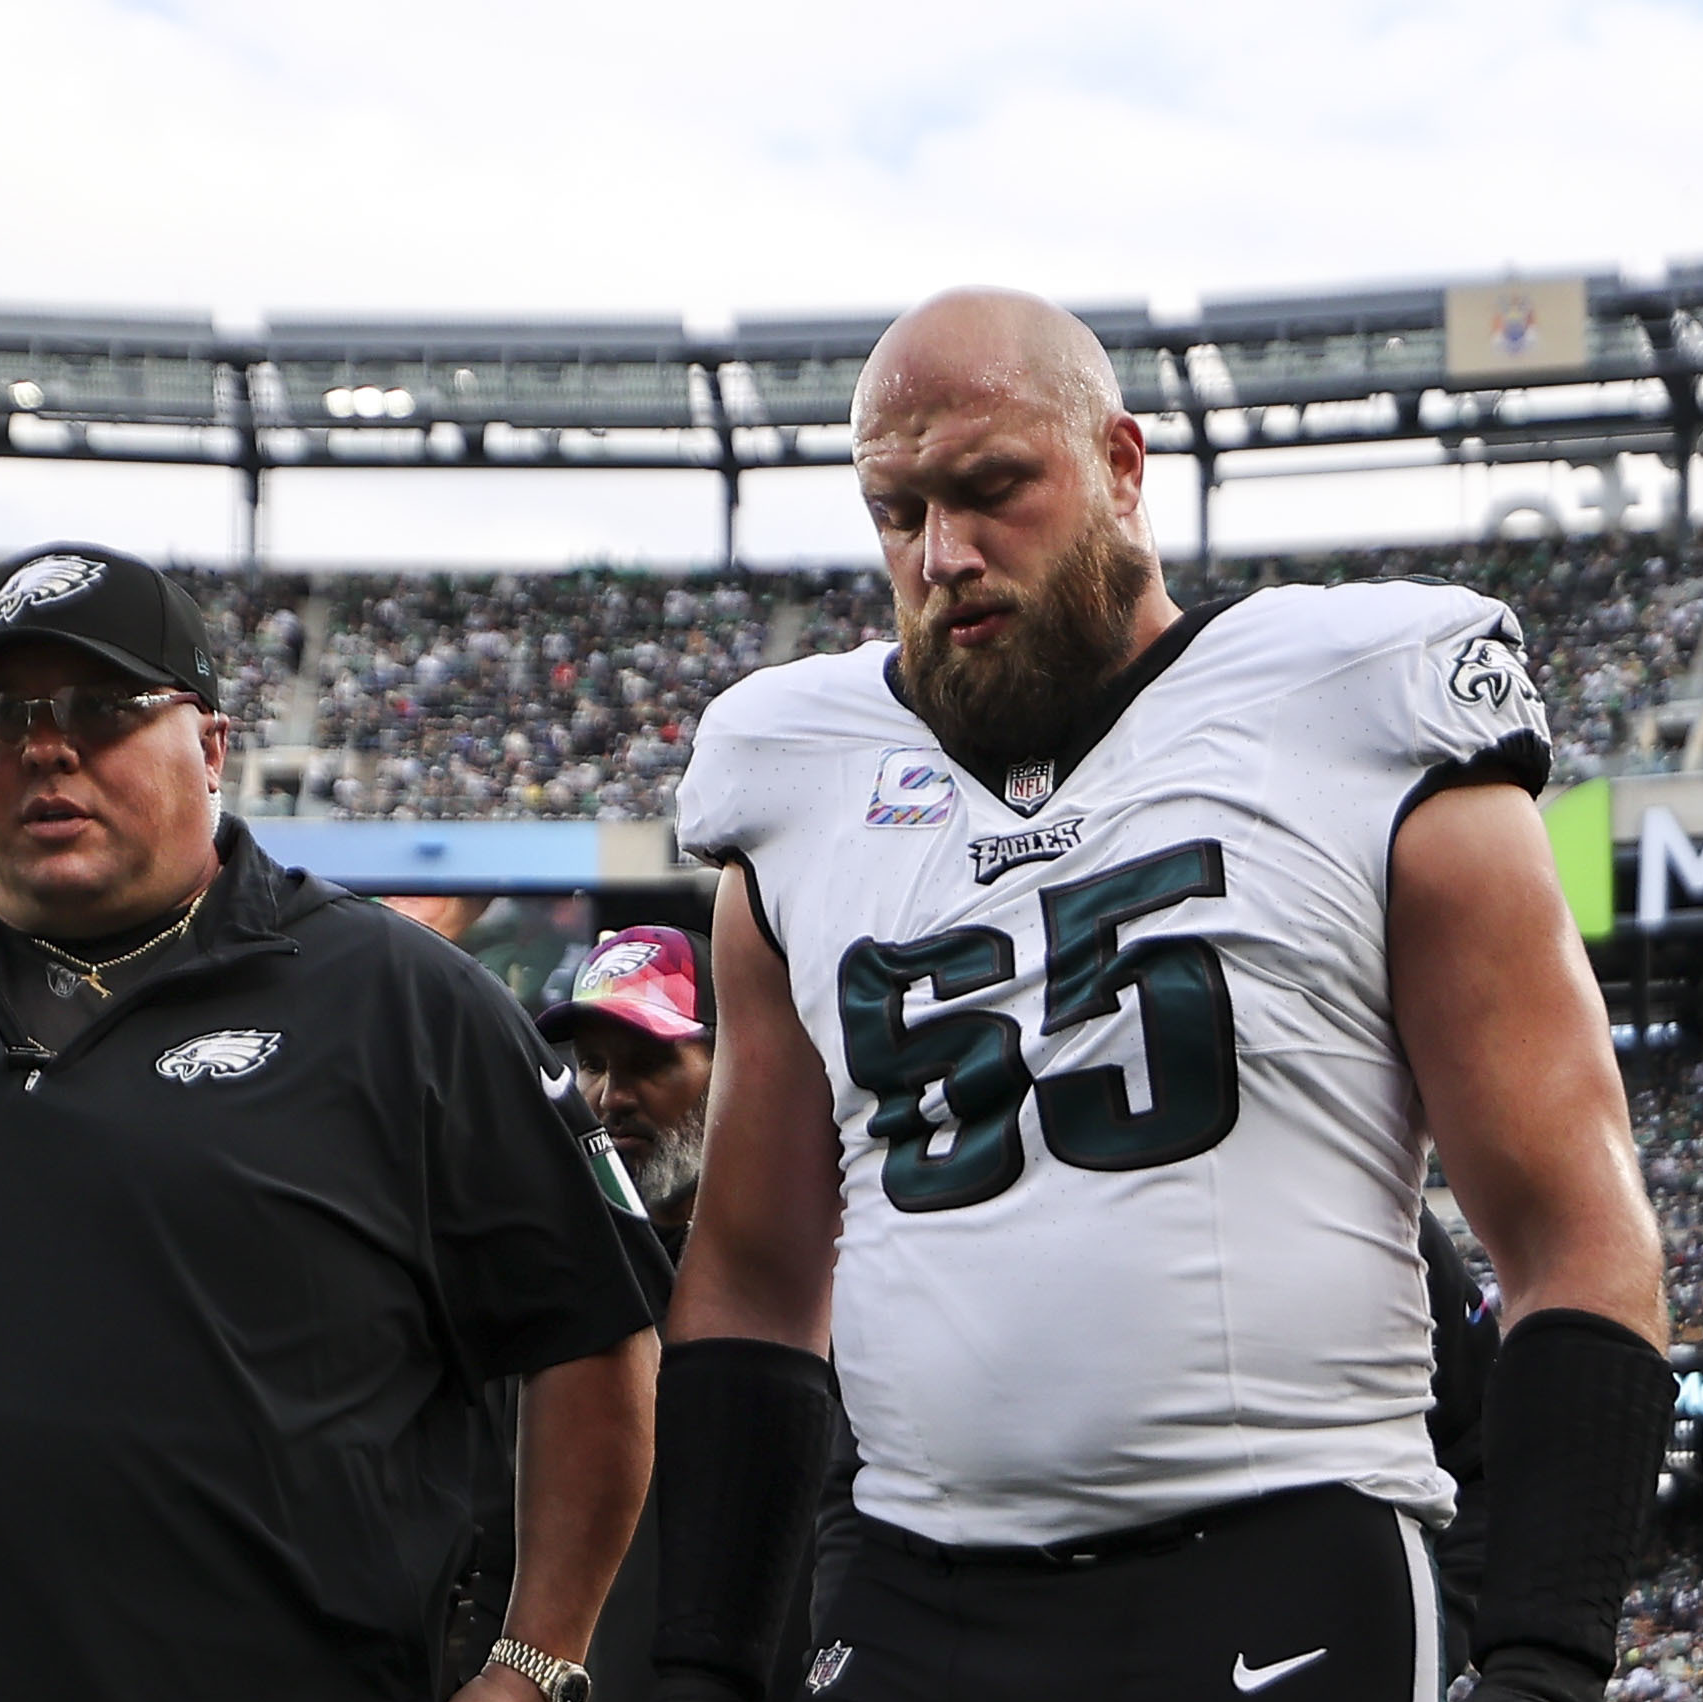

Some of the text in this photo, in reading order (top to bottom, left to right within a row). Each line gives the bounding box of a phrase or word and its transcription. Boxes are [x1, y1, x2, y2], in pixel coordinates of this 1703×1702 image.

[1012, 778, 1045, 798] NFL
[968, 817, 1085, 884] EAGLES
[839, 838, 1239, 1213] 65
[588, 1131, 614, 1154] ITA
